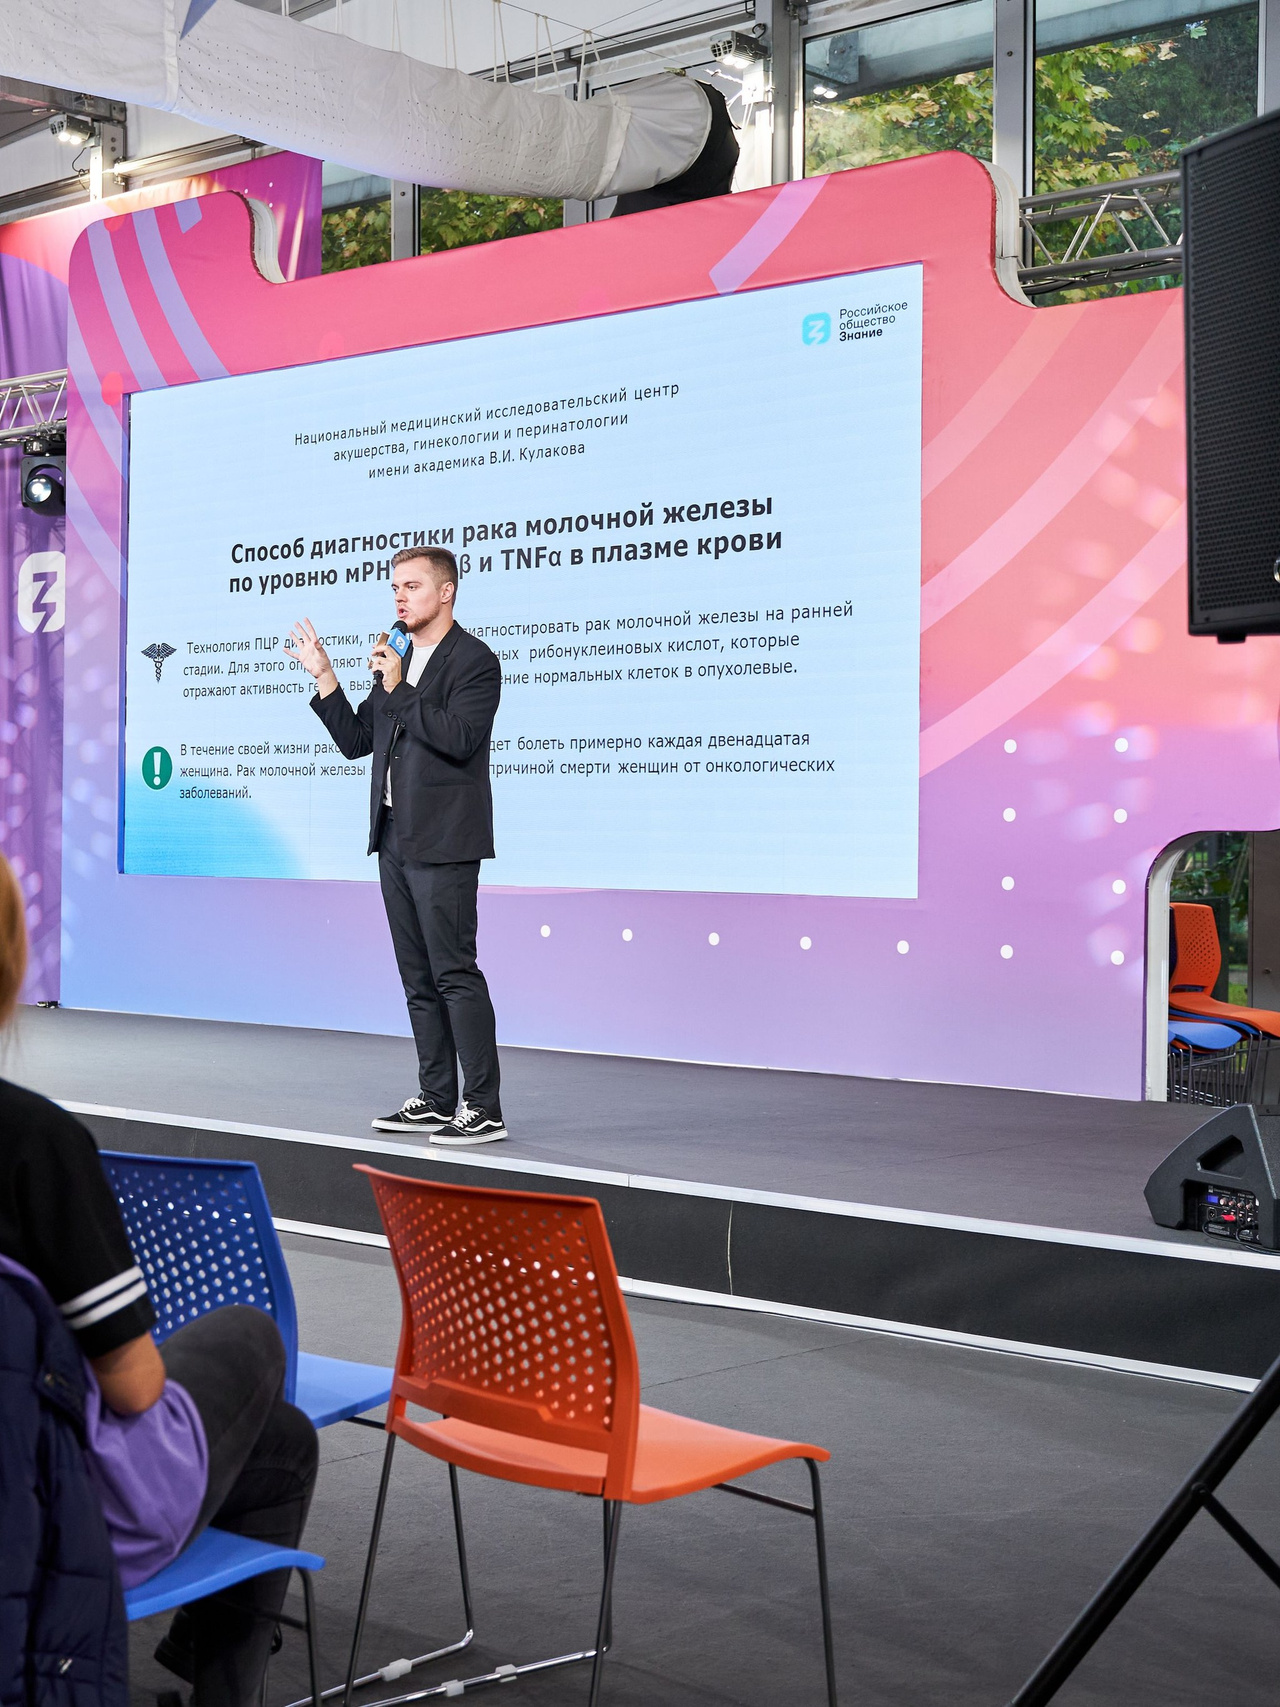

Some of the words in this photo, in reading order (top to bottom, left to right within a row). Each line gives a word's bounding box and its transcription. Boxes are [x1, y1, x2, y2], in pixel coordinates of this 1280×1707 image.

[839, 315, 896, 331] общество
[840, 302, 908, 319] Российское
[839, 328, 883, 342] Знание
[295, 420, 386, 446] Национальный
[391, 407, 481, 432] медицинский
[486, 387, 628, 418] исследовательский
[634, 384, 679, 401] центр
[333, 443, 409, 462] акушерства,
[414, 431, 499, 451] гинекологии
[504, 429, 511, 439] и
[517, 414, 628, 439] перинатологии
[369, 465, 409, 479] имени
[414, 455, 485, 473] академика
[490, 449, 515, 464] В.И.
[519, 443, 585, 463] Кулакова
[231, 537, 304, 564] Способ
[310, 528, 454, 560] диагностики
[463, 521, 517, 548] рака
[526, 501, 653, 536] молочной
[663, 497, 772, 524] железы
[230, 576, 253, 593] по
[259, 569, 338, 595] уровню
[346, 559, 391, 583] мРН
[479, 556, 492, 573] и
[571, 548, 584, 565] в
[592, 539, 688, 564] плазме
[697, 531, 782, 560] крови
[186, 641, 250, 654] Технология
[255, 636, 279, 652] ПЦР
[585, 619, 610, 635] рак
[617, 610, 691, 629] молочной
[698, 610, 758, 625] железы
[766, 609, 784, 621] на
[791, 600, 853, 623] ранней
[183, 665, 224, 677] стадии.
[228, 661, 249, 676] Для
[254, 661, 285, 673] этого
[530, 642, 662, 663] рибонуклеиновых
[668, 639, 724, 653] кислот,
[731, 635, 800, 651] которые
[183, 686, 237, 700] отражают
[240, 683, 304, 695] активность
[534, 669, 622, 686] нормальных
[628, 667, 679, 680] клеток
[684, 666, 693, 678] в
[698, 662, 797, 680] опухолевые.
[181, 744, 187, 756] В
[190, 745, 234, 756] течение
[238, 741, 270, 755] своей
[273, 744, 310, 754] жизни
[517, 736, 565, 750] болеть
[570, 737, 642, 753] примерно
[648, 736, 702, 750] каждая
[708, 734, 809, 749] двенадцатая
[180, 767, 232, 779] женщина.
[237, 764, 256, 777] Рак
[260, 762, 316, 777] молочной
[320, 765, 365, 776] железы
[560, 763, 610, 777] смерти
[618, 762, 678, 775] женщин
[684, 761, 701, 773] от
[706, 760, 835, 773] онкологических
[179, 785, 252, 799] заболеваний.
